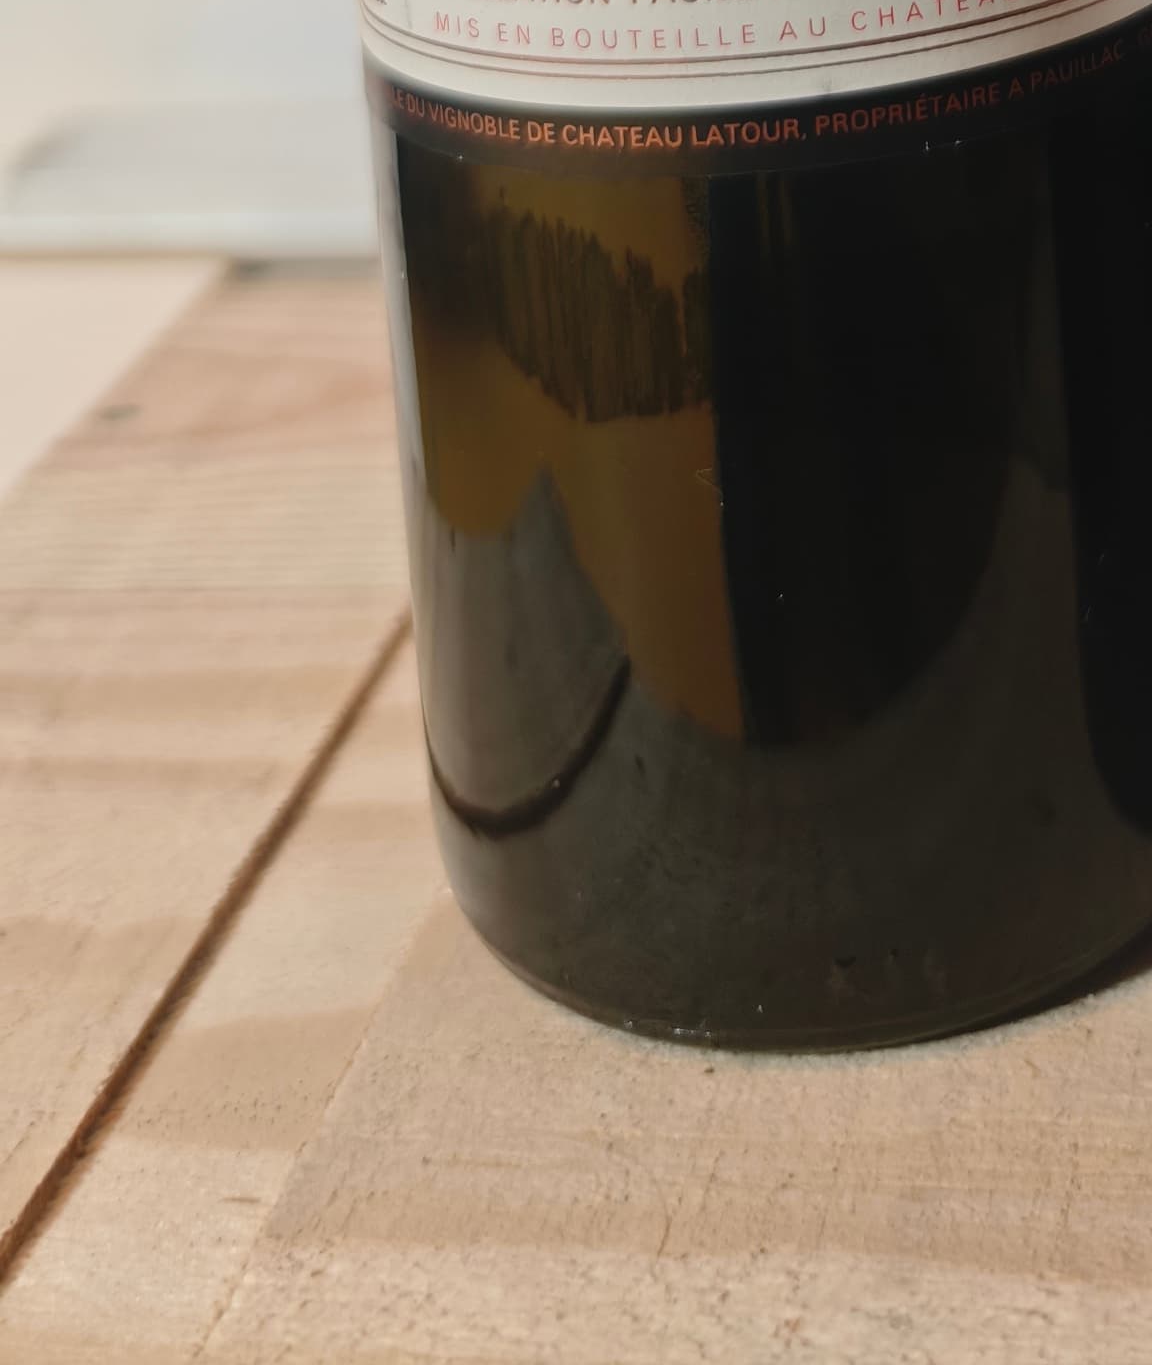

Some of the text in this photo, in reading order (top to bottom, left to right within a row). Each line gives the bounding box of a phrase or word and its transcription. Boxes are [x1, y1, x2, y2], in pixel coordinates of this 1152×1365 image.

[435, 12, 480, 38] MIS
[498, 22, 531, 45] EN
[551, 24, 756, 50] BOUTEILLE
[779, 17, 826, 41] AU
[407, 93, 425, 118] DU
[429, 103, 521, 140] VIGNOBLE
[527, 120, 555, 144] DE
[562, 124, 683, 148] CHATEAU
[691, 118, 807, 147] LATOUR,
[815, 83, 1001, 136] PROPRIÉTAIRE
[1029, 37, 1125, 94] PAUILLAC
